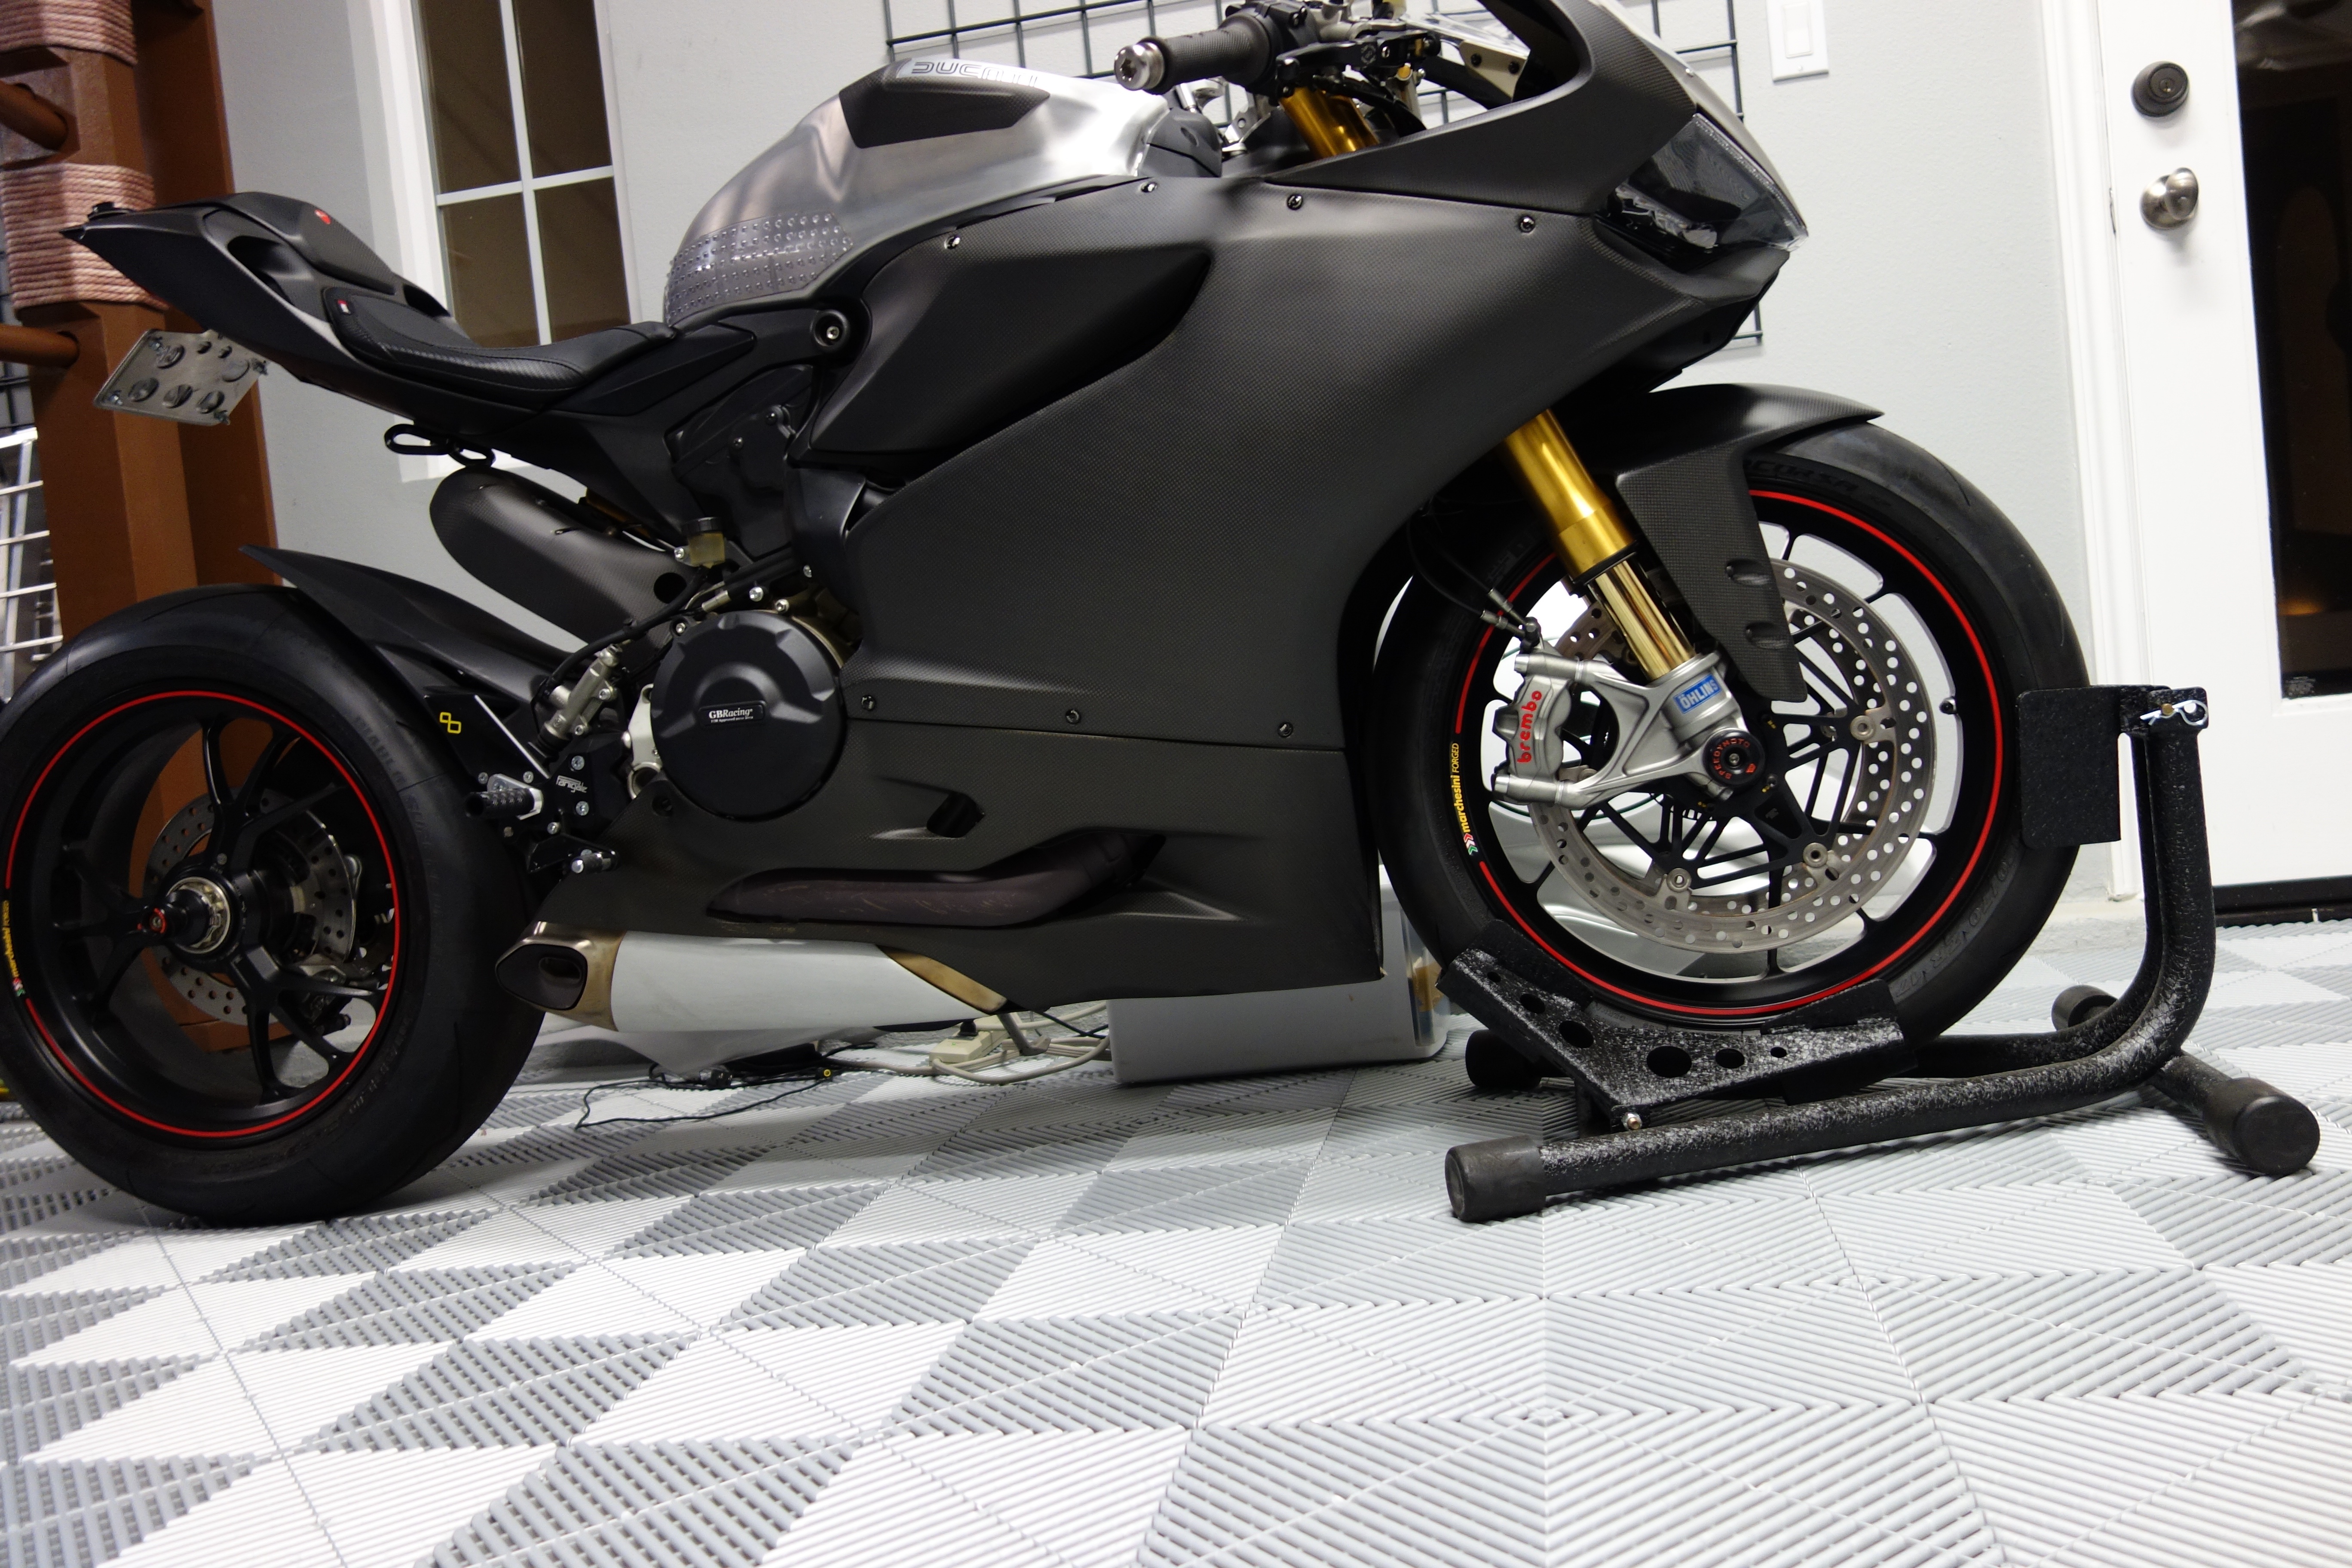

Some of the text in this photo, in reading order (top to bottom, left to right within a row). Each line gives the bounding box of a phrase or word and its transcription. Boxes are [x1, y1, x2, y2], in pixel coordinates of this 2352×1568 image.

[1516, 690, 1542, 763] brembo
[1678, 679, 1719, 709] ÖHLINS
[1450, 743, 1471, 833] marchesini FORGED
